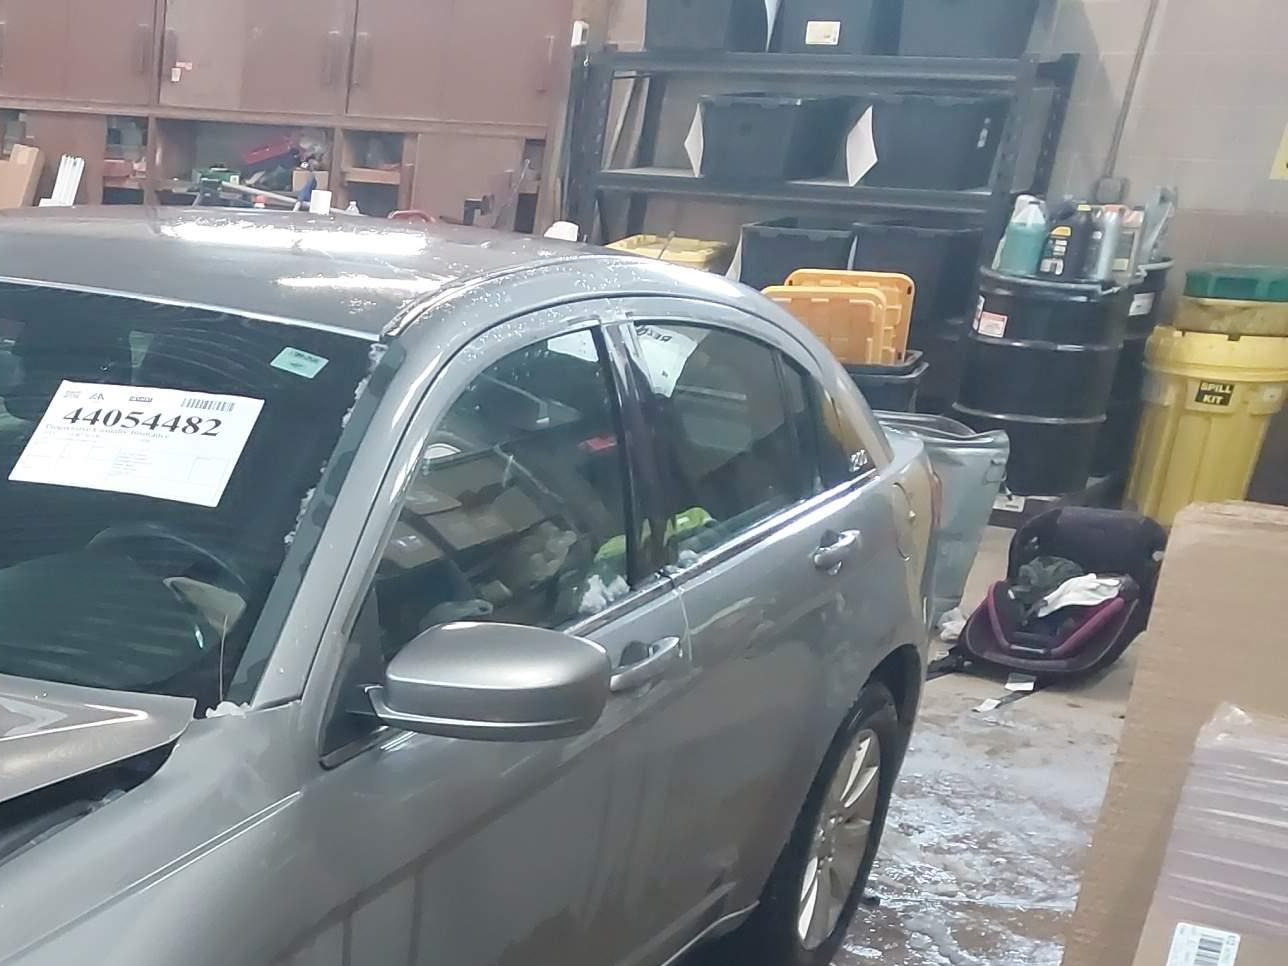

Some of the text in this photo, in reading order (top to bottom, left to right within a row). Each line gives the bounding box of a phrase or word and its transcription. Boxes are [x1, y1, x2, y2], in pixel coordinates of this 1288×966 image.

[1201, 382, 1231, 394] SPILL
[1203, 394, 1224, 405] KIT
[63, 407, 222, 437] 44054482
